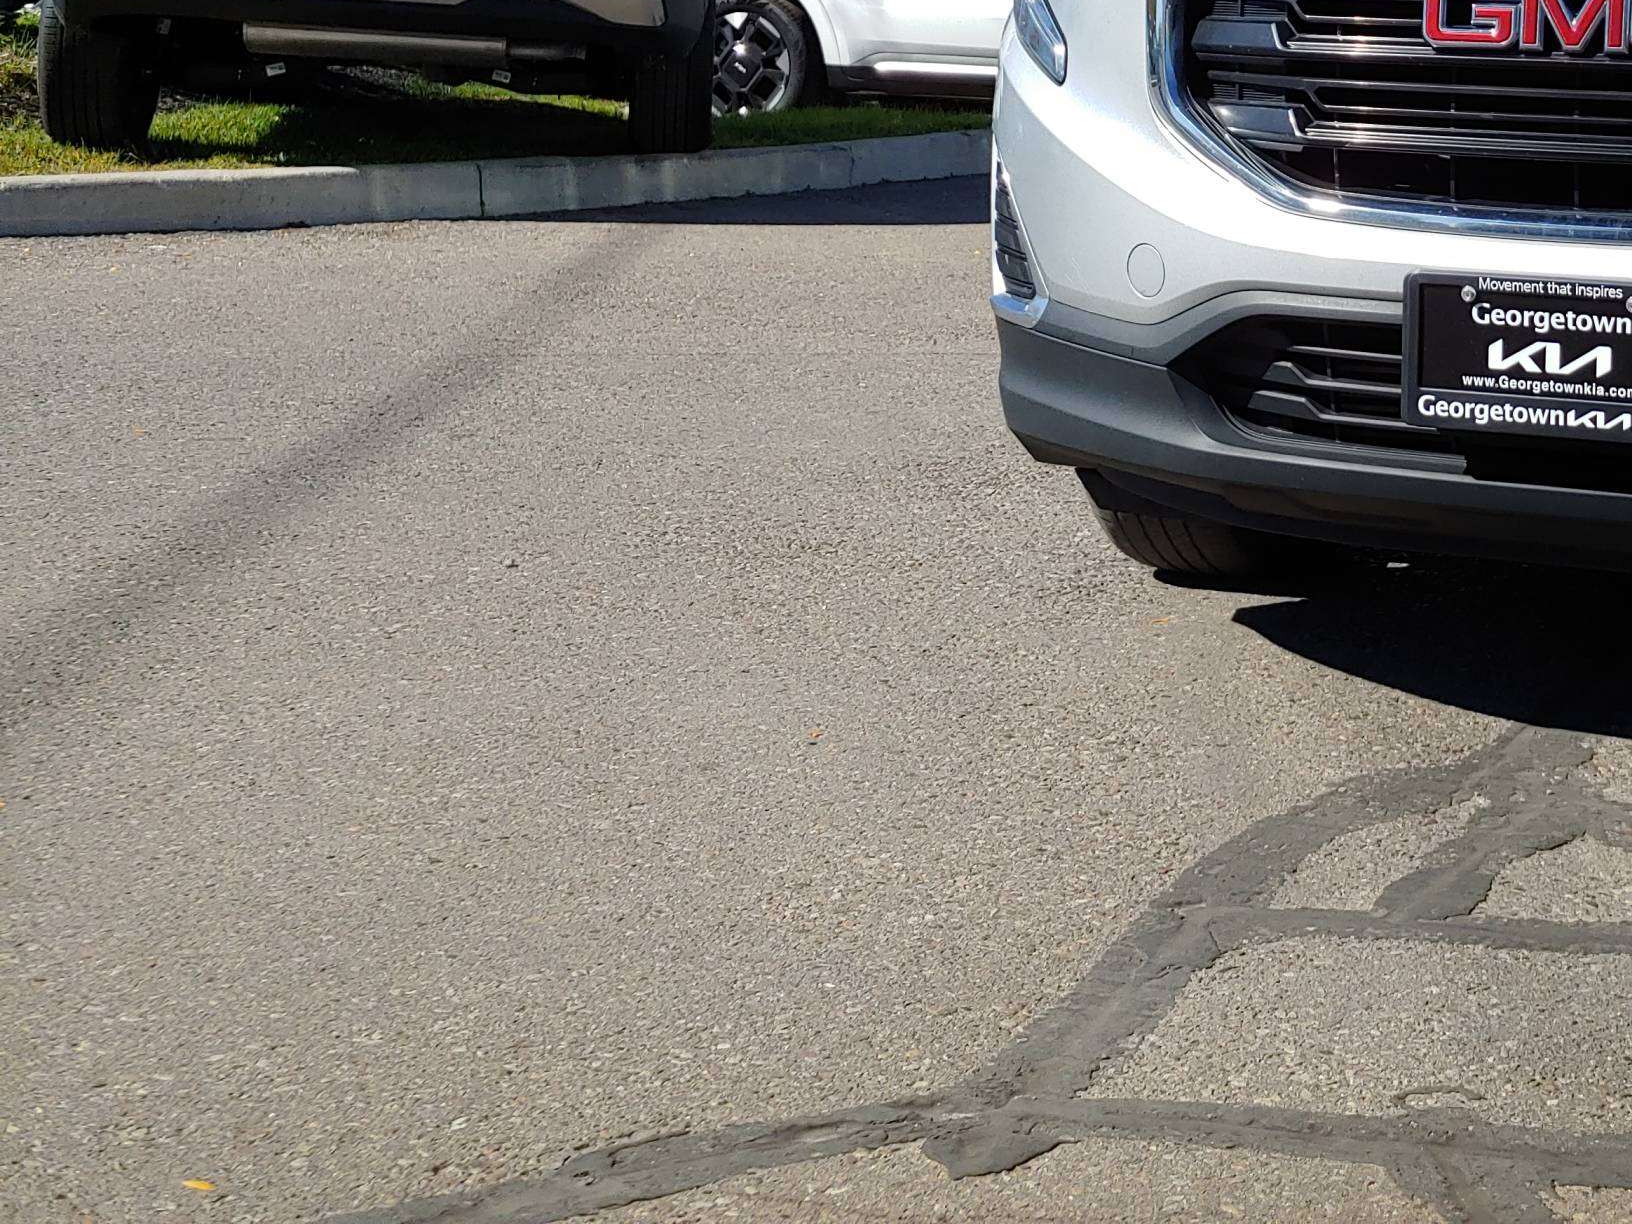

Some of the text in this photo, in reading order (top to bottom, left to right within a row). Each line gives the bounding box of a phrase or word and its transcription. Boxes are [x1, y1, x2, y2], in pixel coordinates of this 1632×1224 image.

[1477, 276, 1624, 300] Movement that inspires
[1471, 302, 1632, 335] Georgetown
[1487, 338, 1613, 378] KIA
